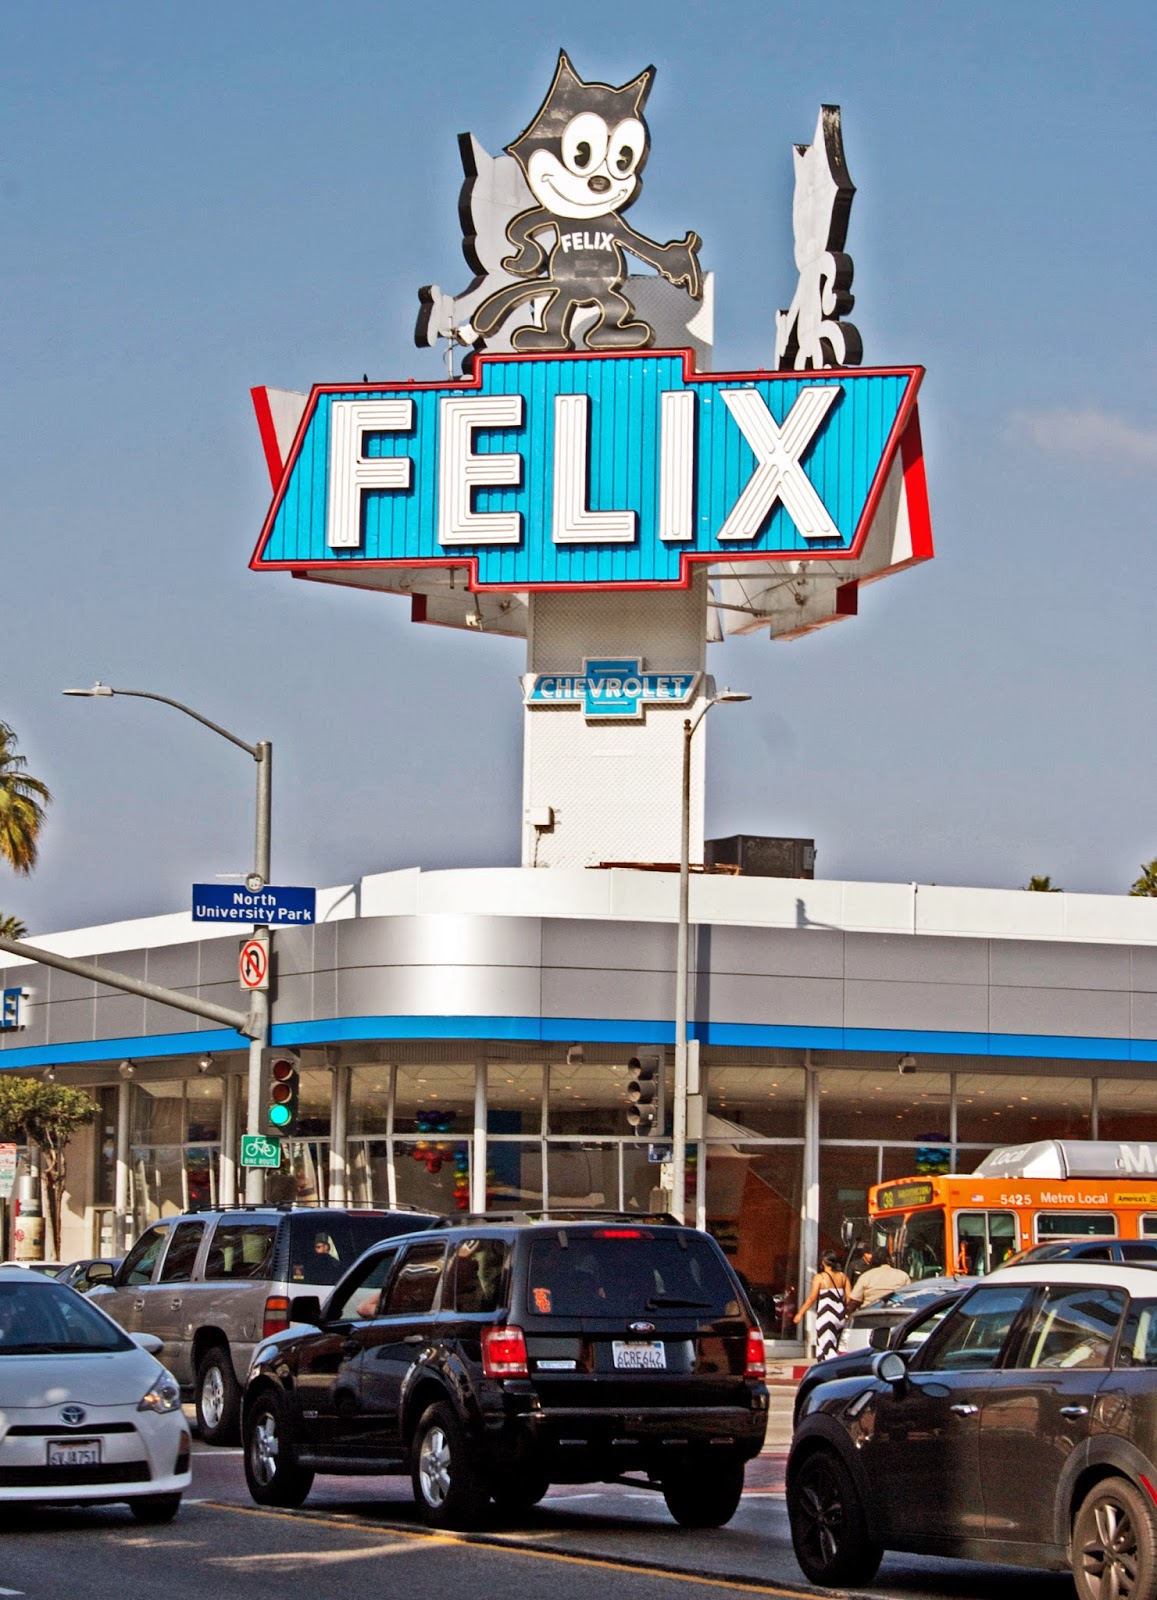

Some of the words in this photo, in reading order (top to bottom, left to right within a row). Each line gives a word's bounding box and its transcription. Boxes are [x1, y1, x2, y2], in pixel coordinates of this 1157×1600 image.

[561, 231, 615, 253] FELIX
[327, 385, 843, 548] FELIX
[540, 677, 686, 698] CHEVROLET
[233, 893, 276, 906] North
[196, 905, 275, 922] University
[278, 908, 312, 920] Park
[0, 987, 24, 1028] ET
[990, 1145, 1033, 1166] Local
[1119, 1144, 1157, 1173] M
[1000, 1194, 1032, 1206] 5425
[1040, 1192, 1075, 1204] Metro
[1078, 1193, 1108, 1205] Local
